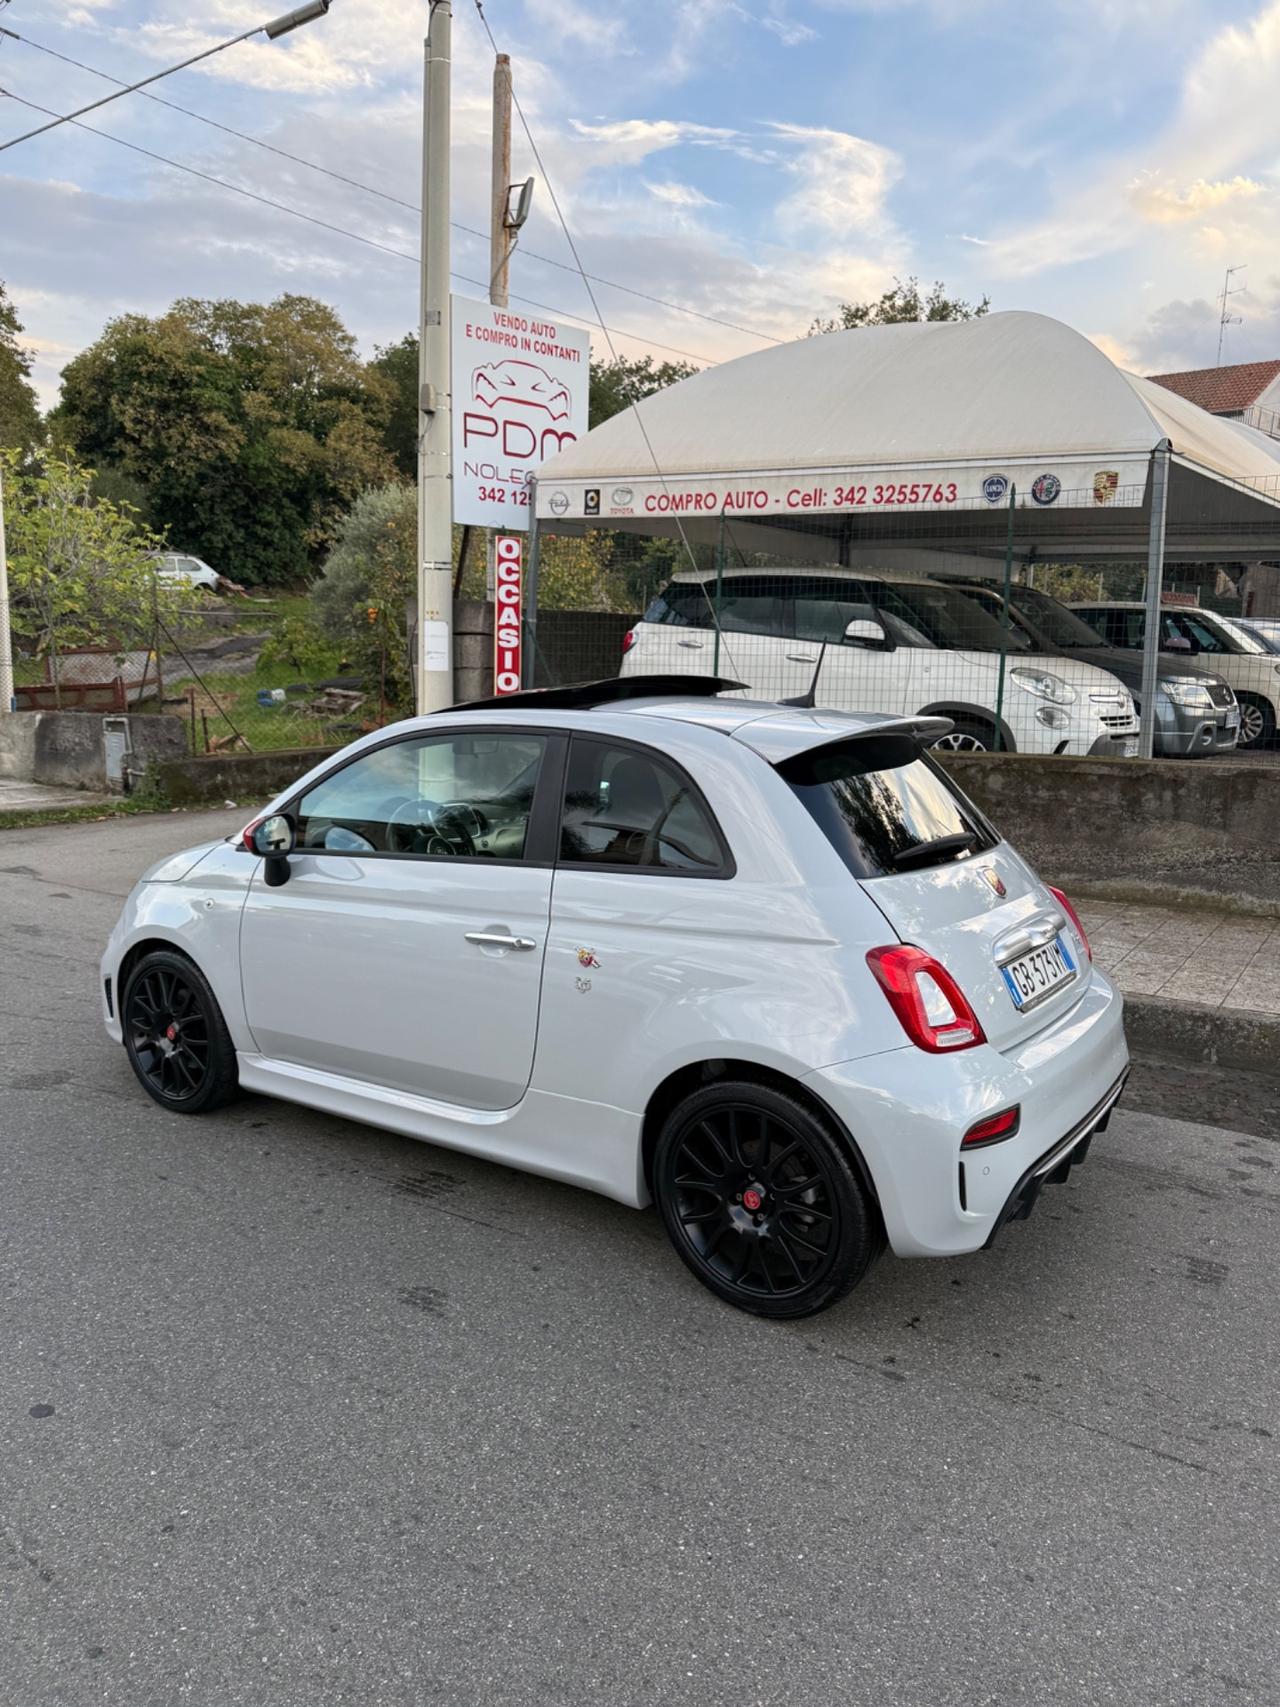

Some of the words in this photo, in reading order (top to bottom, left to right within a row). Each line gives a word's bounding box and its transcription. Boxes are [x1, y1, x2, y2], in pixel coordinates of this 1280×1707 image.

[493, 311, 528, 332] VENDO
[530, 321, 556, 339] AUTO
[465, 323, 473, 338] E
[475, 326, 519, 349] COMPRO
[520, 337, 531, 351] IN
[533, 340, 581, 363] CONTANTI
[478, 486, 506, 503] 342
[644, 490, 717, 512] COMPRO
[722, 489, 768, 510] AUTO
[786, 486, 828, 508] Cell:
[832, 485, 867, 506] 342
[872, 482, 958, 505] 3255763
